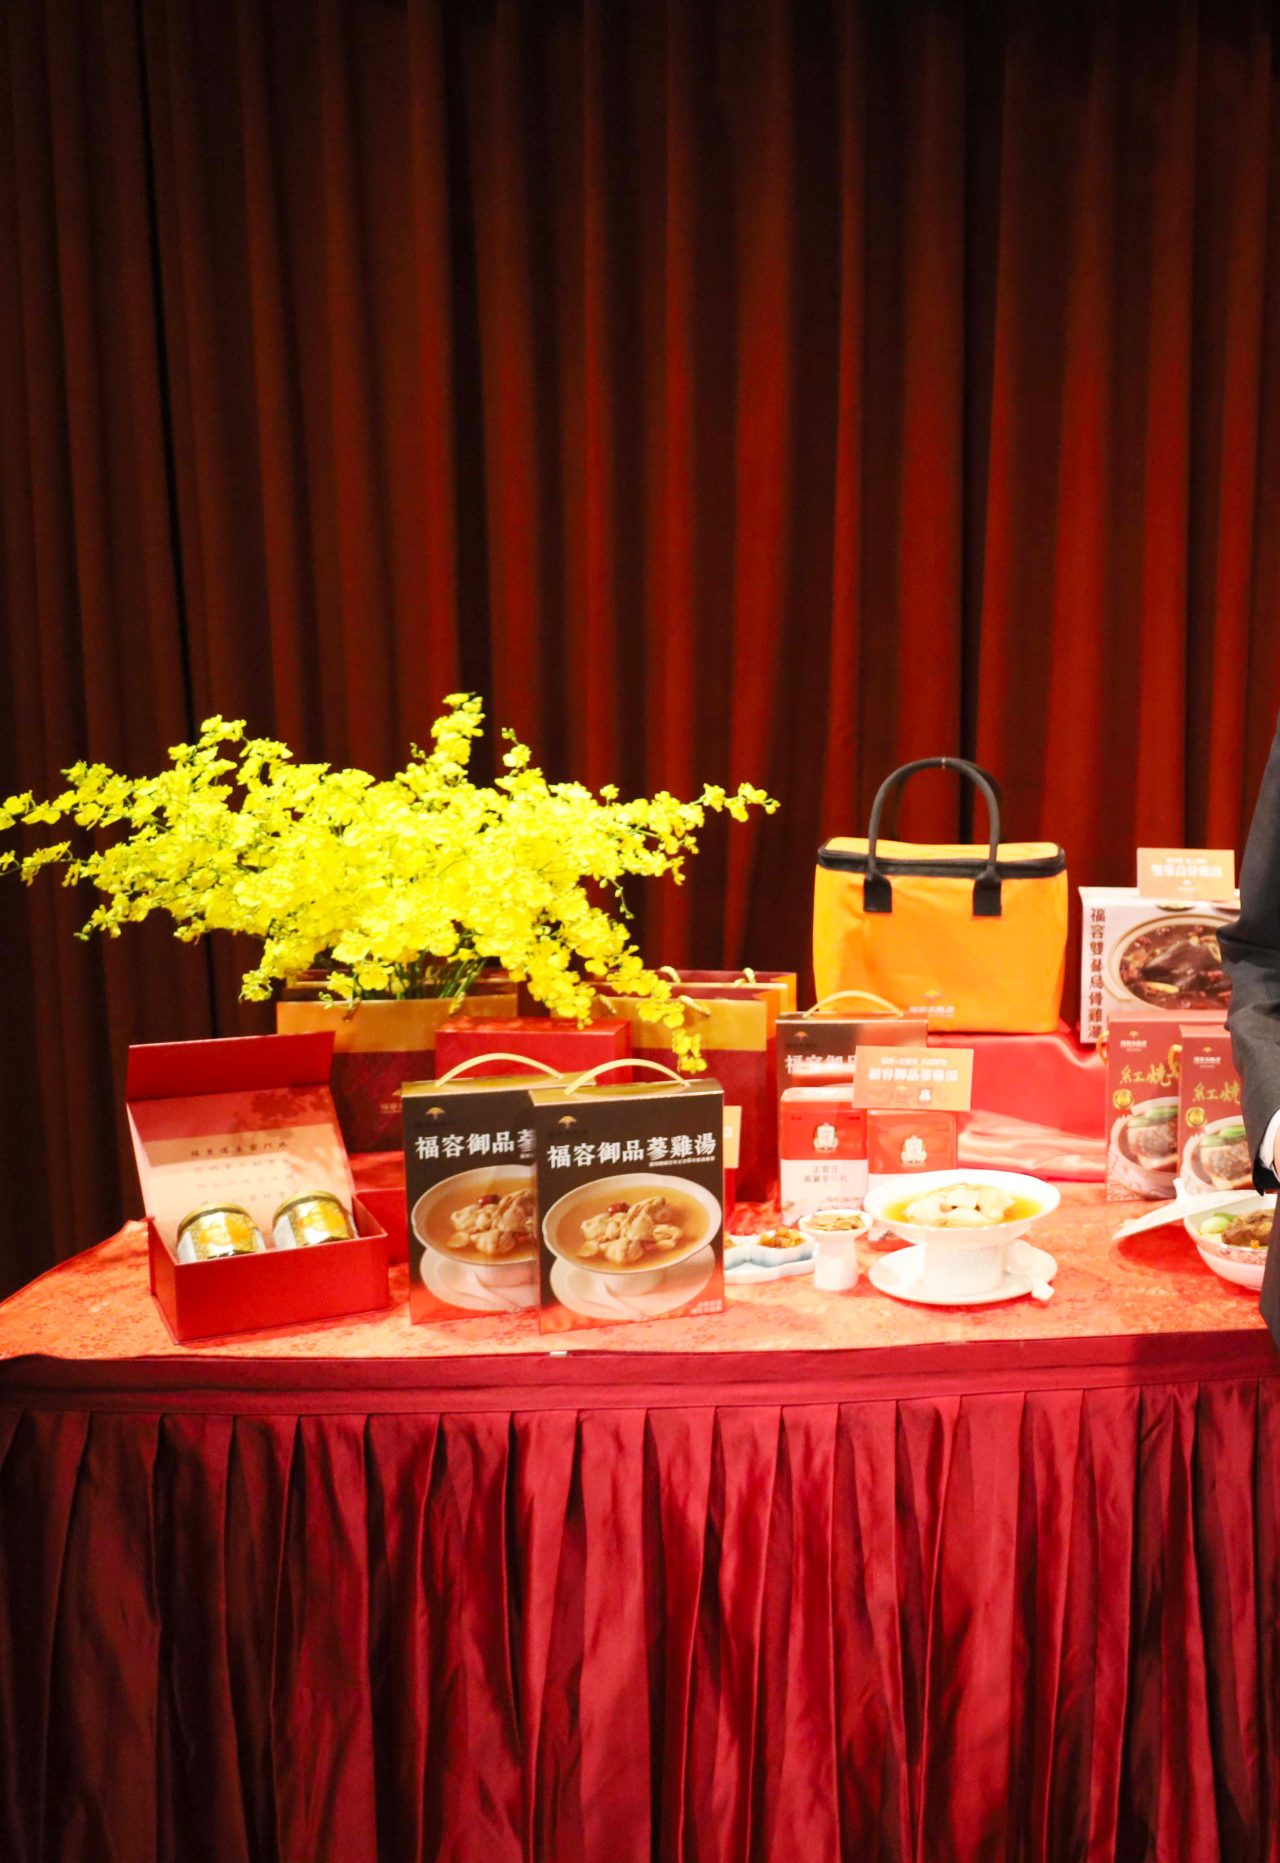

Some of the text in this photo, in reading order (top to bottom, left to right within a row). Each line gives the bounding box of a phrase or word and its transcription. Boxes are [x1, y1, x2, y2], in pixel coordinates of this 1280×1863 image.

[547, 1132, 717, 1169] 福容御品蔘雞湯
